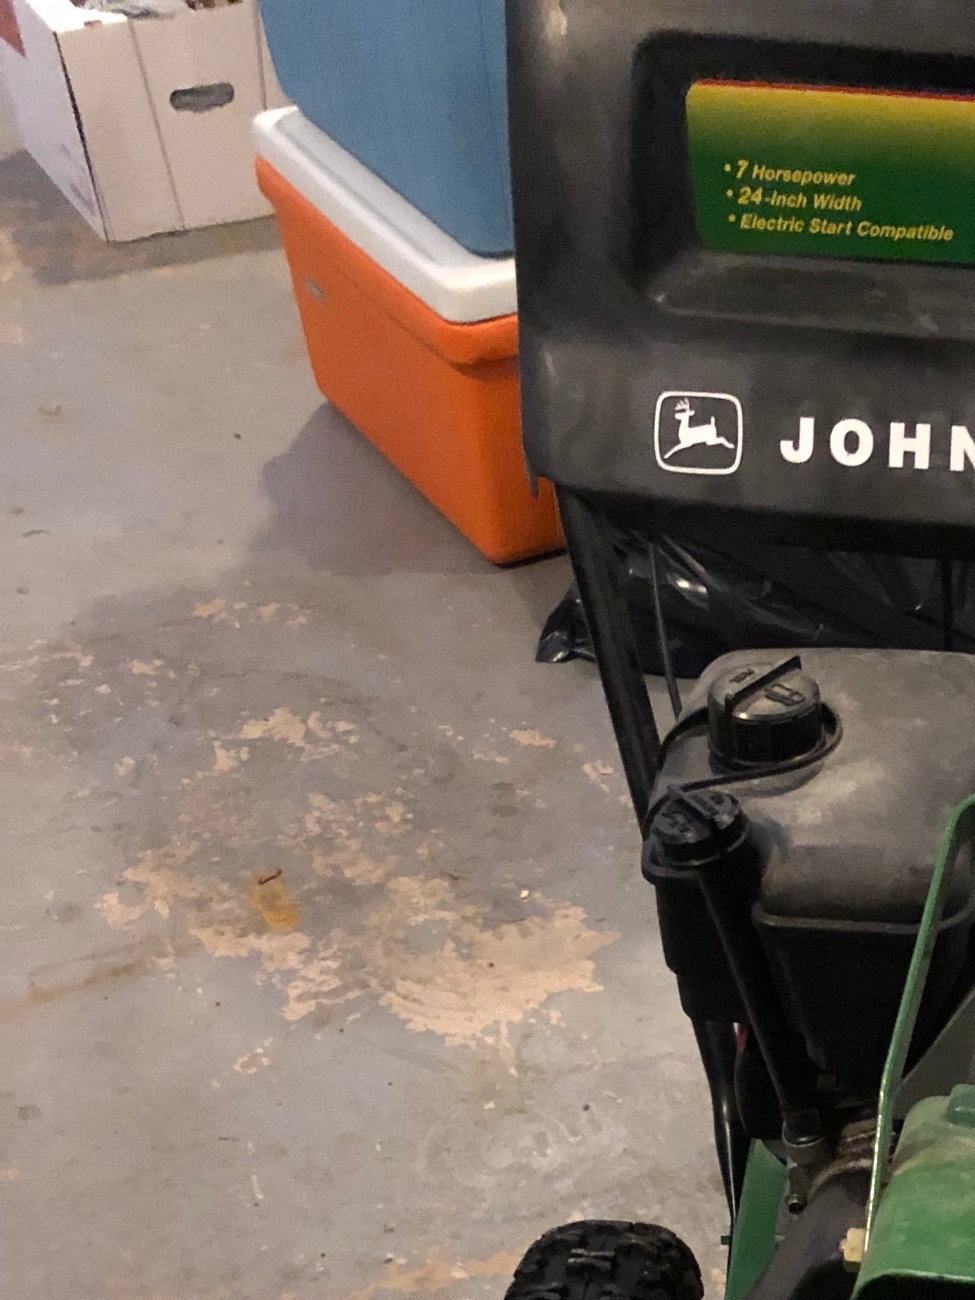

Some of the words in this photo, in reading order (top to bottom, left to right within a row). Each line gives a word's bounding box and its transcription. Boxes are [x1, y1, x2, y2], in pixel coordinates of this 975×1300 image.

[736, 160, 749, 180] 7
[752, 164, 856, 186] Horsepower
[737, 186, 807, 208] 24-Inch
[813, 194, 862, 212] Width
[740, 213, 804, 233] Electric
[809, 218, 852, 236] Start
[857, 221, 954, 241] Compatible
